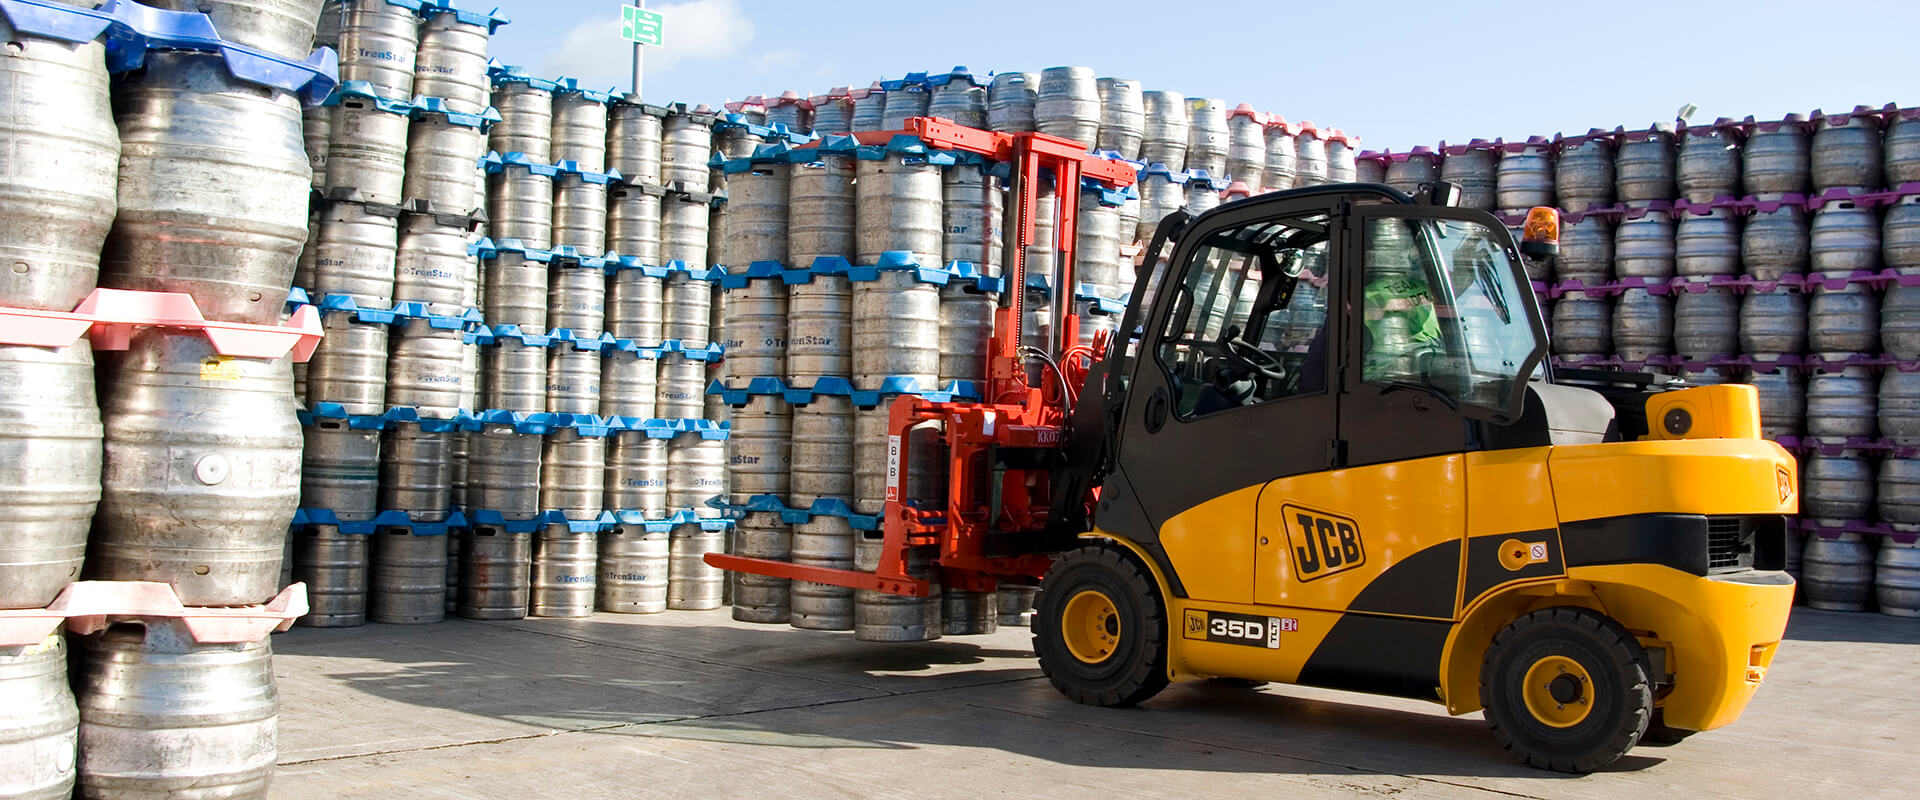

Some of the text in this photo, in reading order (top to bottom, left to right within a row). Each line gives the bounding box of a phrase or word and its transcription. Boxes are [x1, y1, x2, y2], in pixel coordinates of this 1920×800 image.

[1296, 513, 1360, 574] JCB
[1210, 618, 1264, 640] 35D
[1270, 622, 1278, 643] TLT
